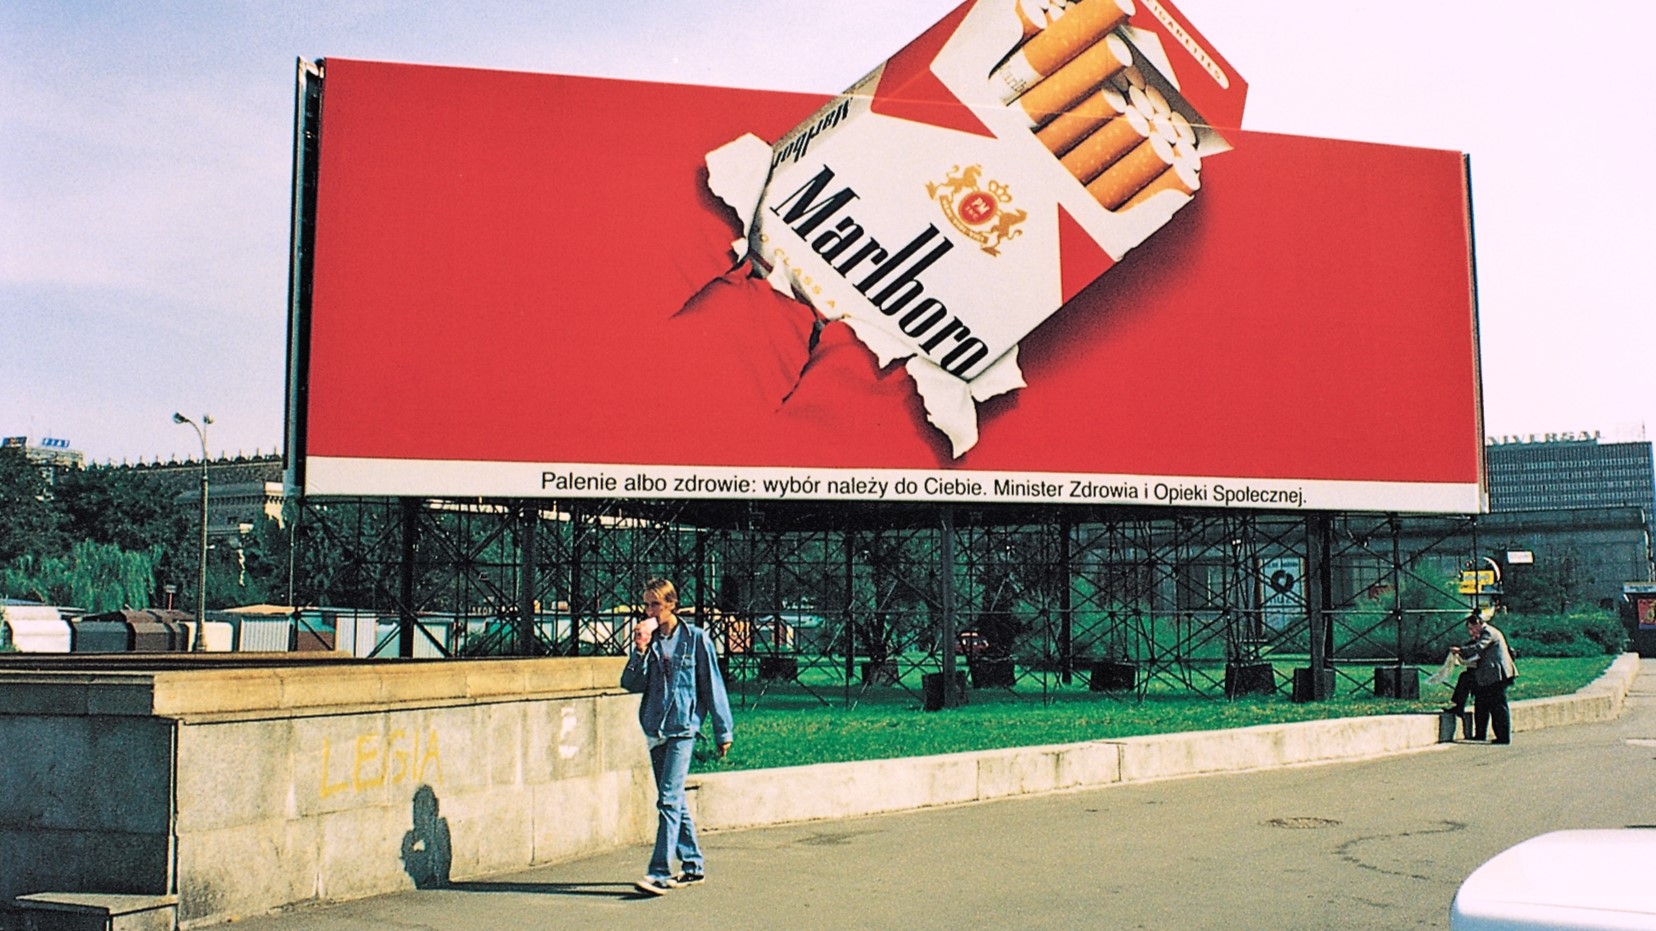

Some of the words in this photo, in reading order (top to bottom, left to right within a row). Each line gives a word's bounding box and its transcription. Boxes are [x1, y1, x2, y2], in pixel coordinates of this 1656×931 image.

[1146, 0, 1221, 80] IGARETTES
[971, 197, 990, 215] PM
[769, 163, 989, 377] Marlboro
[541, 471, 618, 491] Palenie
[624, 473, 667, 492] albo
[673, 474, 757, 494] zdrowie:
[762, 475, 821, 499] wybór
[827, 476, 889, 499] należy
[894, 477, 919, 496] do
[924, 476, 988, 497] Ciebie.
[994, 478, 1064, 498] Minister
[1069, 480, 1139, 500] Zdrowia
[1143, 482, 1150, 500] i
[1153, 482, 1208, 503] Opieki
[1213, 484, 1308, 508] Społecznej.
[320, 728, 443, 798] LEGIA
